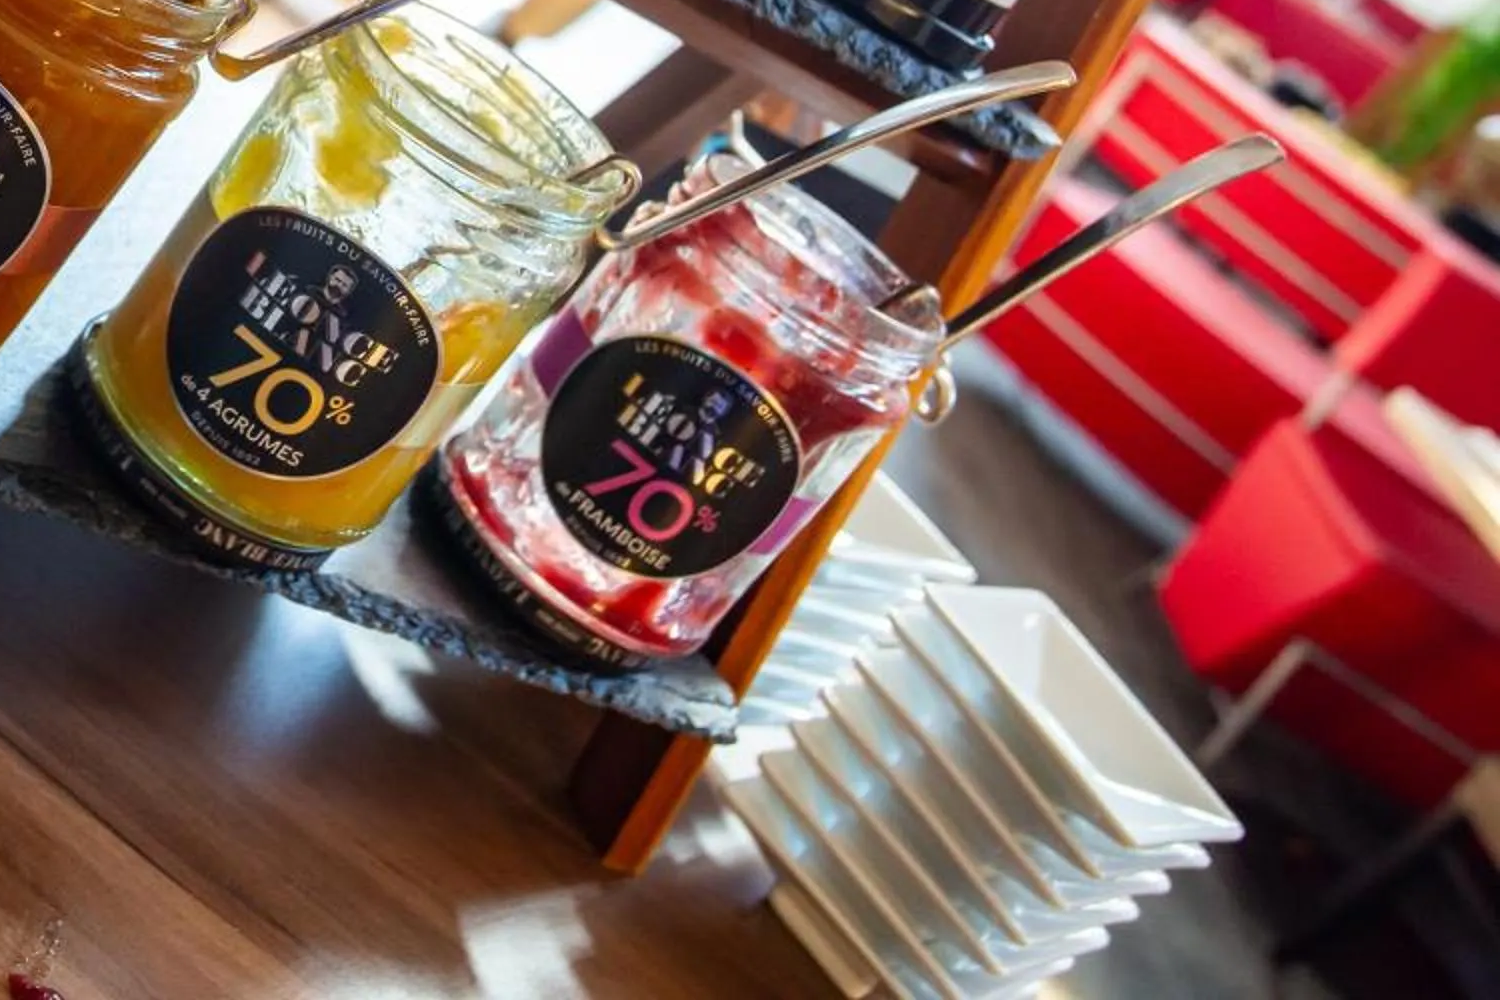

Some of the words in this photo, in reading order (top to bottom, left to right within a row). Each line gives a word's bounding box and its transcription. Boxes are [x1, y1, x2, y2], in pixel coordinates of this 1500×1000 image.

[283, 219, 336, 248] FRUITS
[337, 241, 360, 263] DU
[240, 284, 371, 388] BLANC
[195, 387, 212, 402] 4
[208, 397, 305, 468] AGRUMES
[617, 403, 735, 499] BLANC
[737, 380, 794, 465] SAVOIRFAIRE
[569, 489, 674, 571] FRAMBOISE
